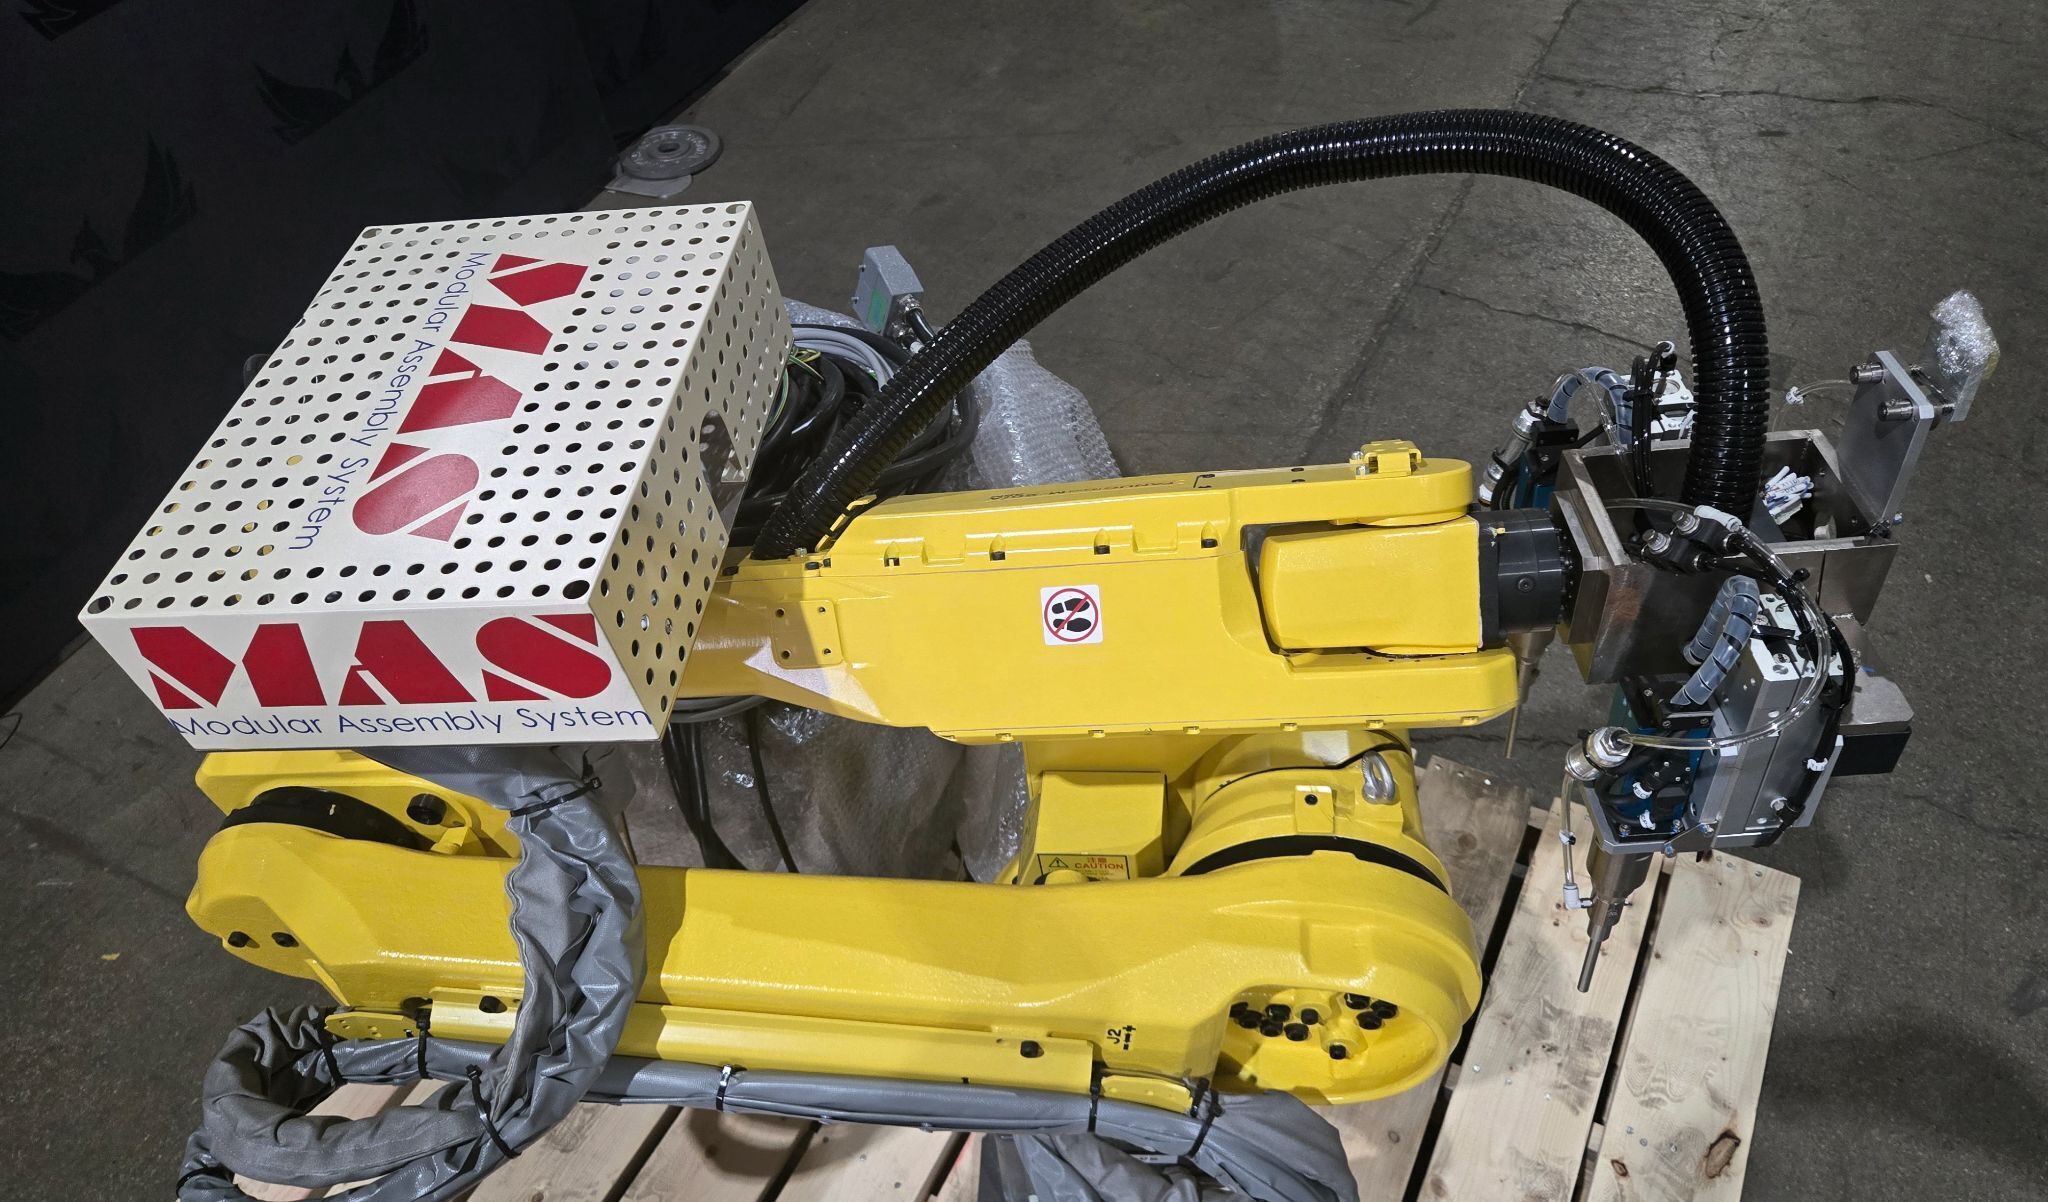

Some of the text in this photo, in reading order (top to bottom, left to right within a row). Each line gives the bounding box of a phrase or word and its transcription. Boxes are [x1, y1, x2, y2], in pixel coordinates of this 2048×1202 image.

[288, 251, 493, 550] Modular Assembly System
[352, 253, 589, 543] MAS
[130, 613, 612, 710] MAS
[168, 706, 653, 736] Modular Assembly System
[1074, 862, 1124, 870] CAUTION
[1106, 1028, 1122, 1045] J2
